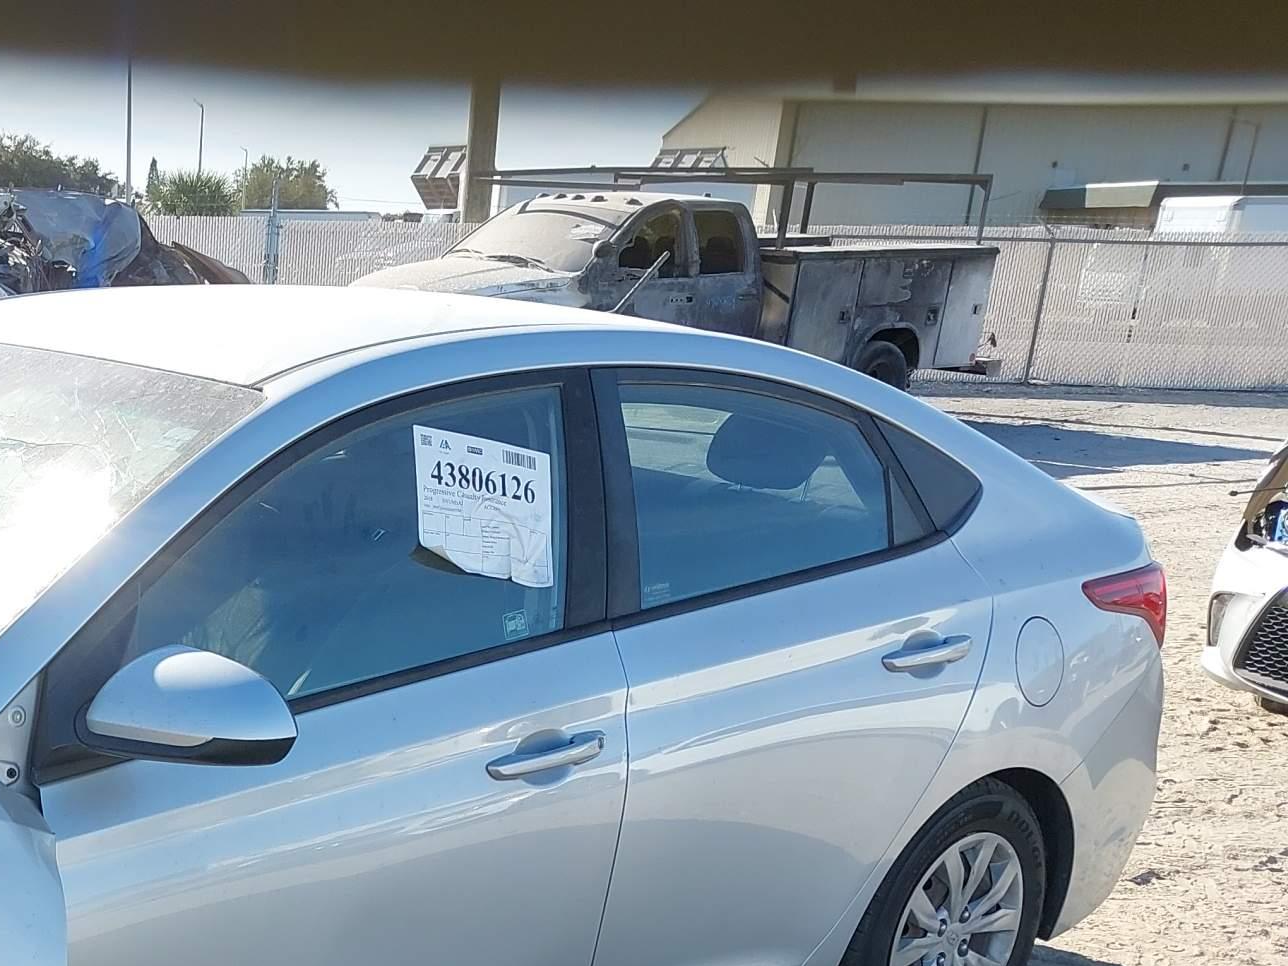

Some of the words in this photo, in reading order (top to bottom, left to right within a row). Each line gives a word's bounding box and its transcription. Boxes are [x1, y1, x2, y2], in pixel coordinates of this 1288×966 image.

[423, 486, 456, 497] Progressive
[457, 491, 481, 501] Casualty
[430, 460, 536, 504] 43806126
